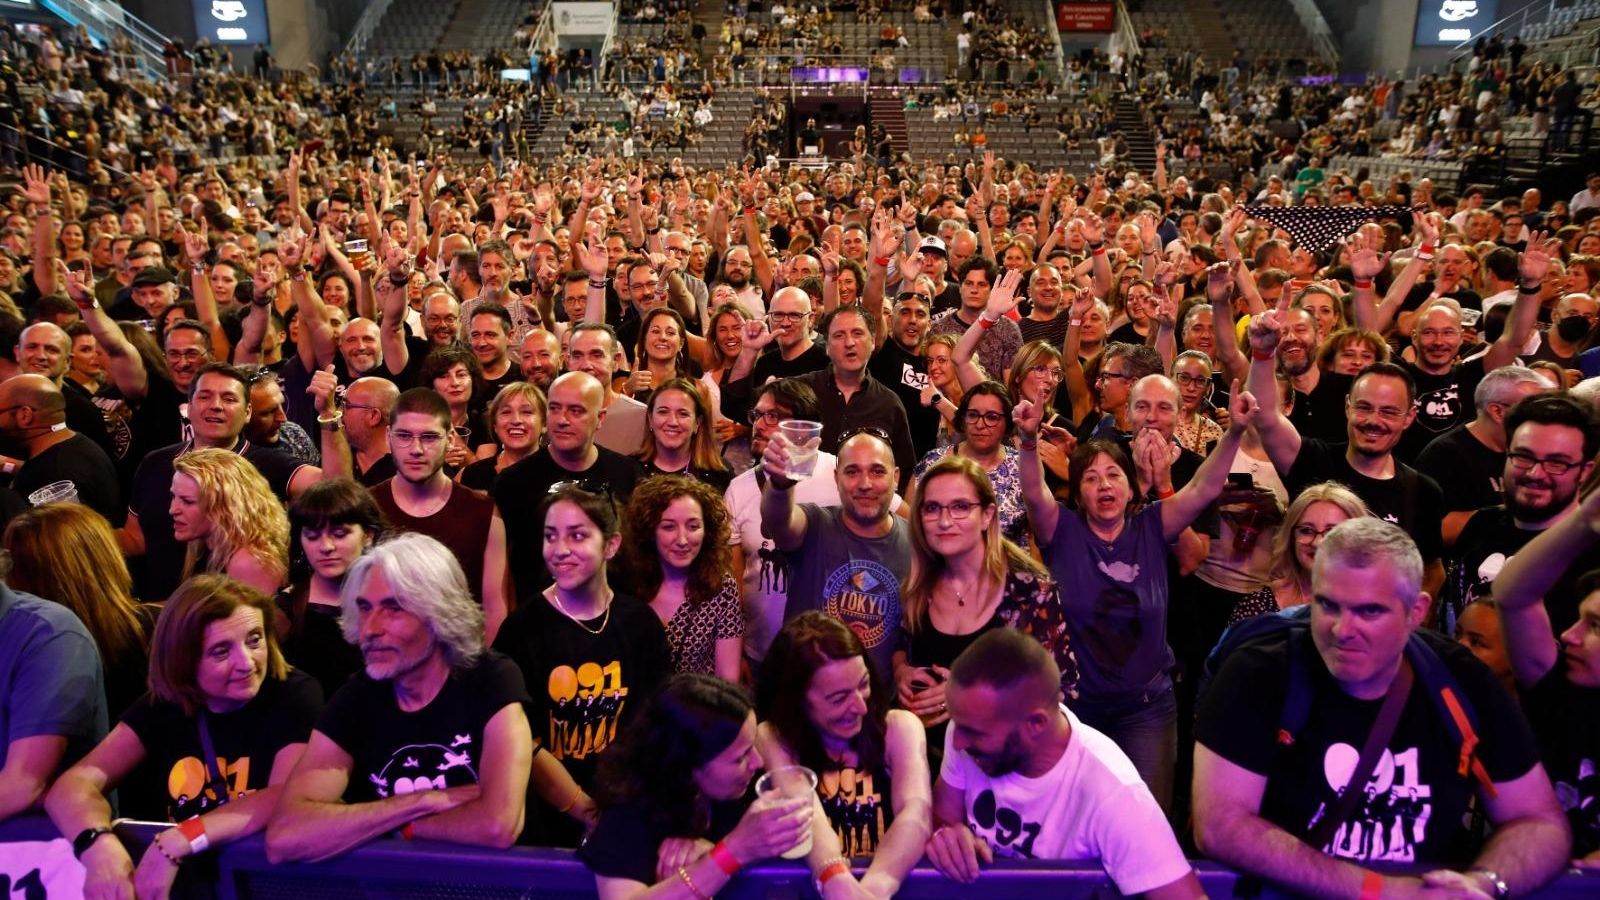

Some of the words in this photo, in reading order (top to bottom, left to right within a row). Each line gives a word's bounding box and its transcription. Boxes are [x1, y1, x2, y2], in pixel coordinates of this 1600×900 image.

[840, 591, 888, 616] TOKYO
[548, 660, 629, 703] 091
[972, 788, 1041, 859] 091
